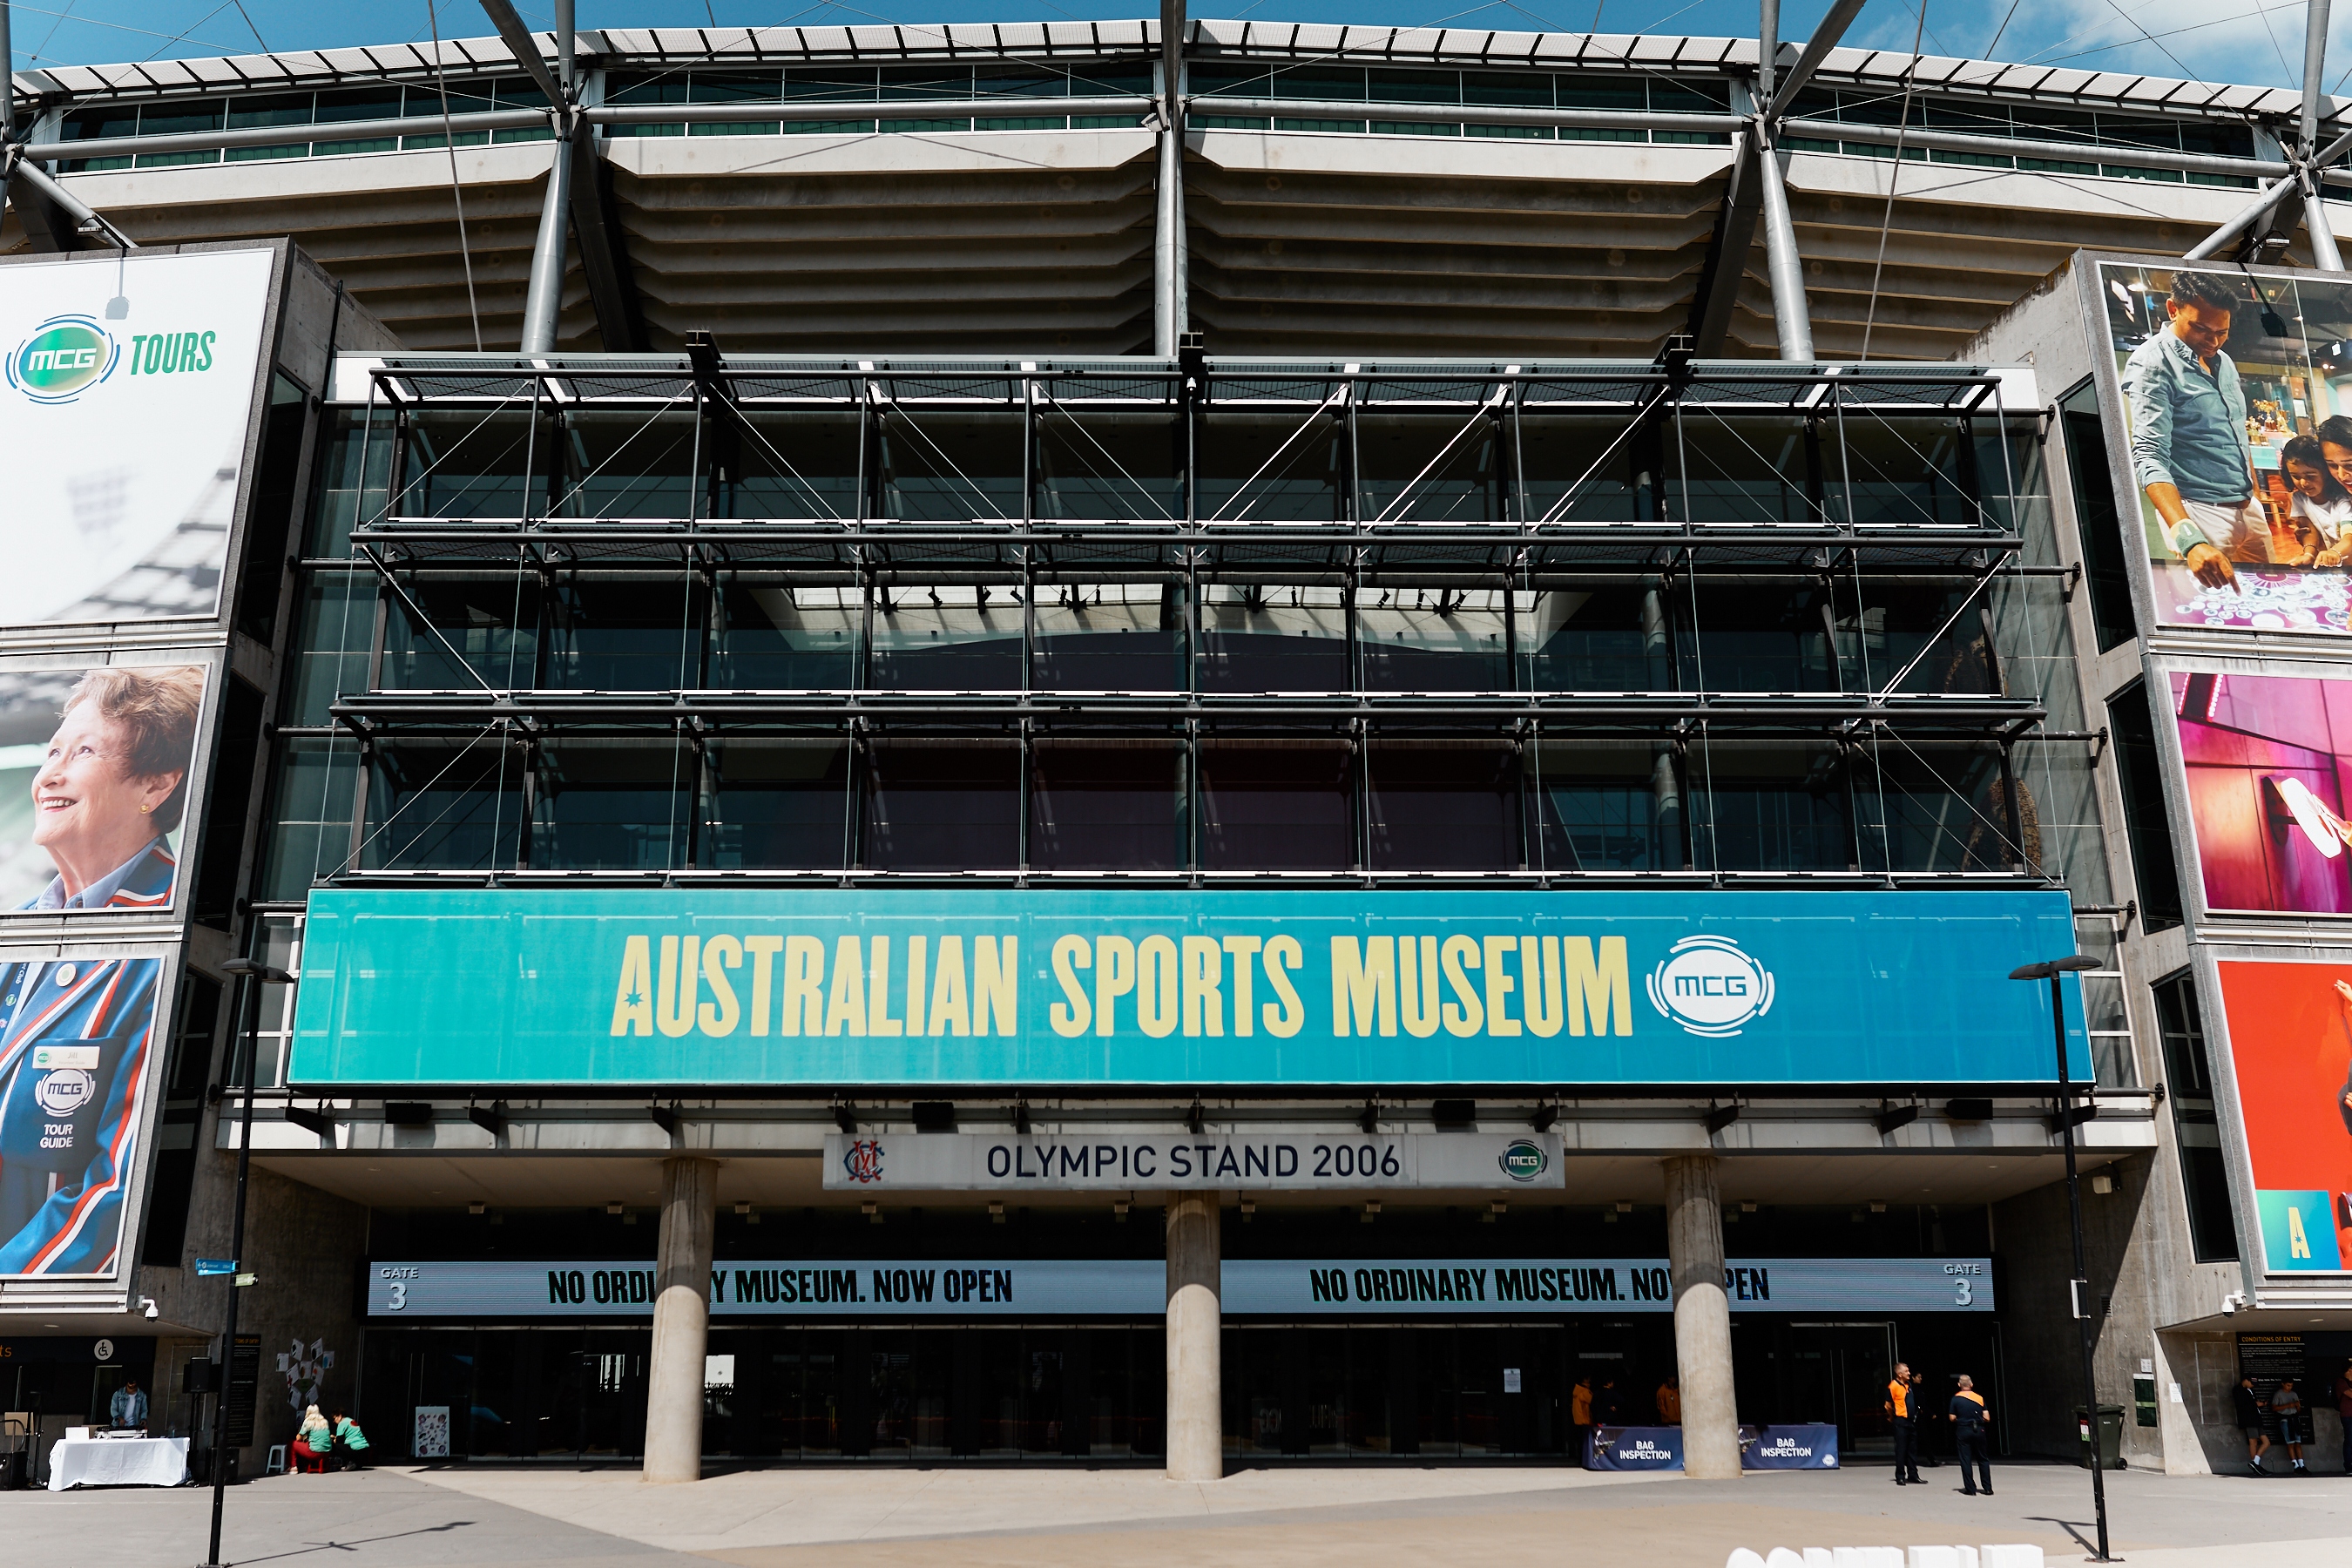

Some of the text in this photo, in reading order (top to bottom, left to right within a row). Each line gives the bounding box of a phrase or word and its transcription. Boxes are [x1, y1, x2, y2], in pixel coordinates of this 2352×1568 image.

[28, 330, 216, 375] MCG TOURS
[611, 934, 1633, 1037] AUSTRALIAN SPORTS MUSEUM
[1674, 976, 1747, 997] MCG
[47, 1083, 83, 1095] MCG
[44, 1124, 73, 1135] TOUR
[39, 1137, 73, 1148] GUIDE
[986, 1145, 1401, 1179] OLYMPIC STAND 2006
[1509, 1156, 1538, 1166] MCG
[381, 1267, 419, 1280] GATE
[1943, 1263, 1982, 1276] GATE
[548, 1269, 1013, 1304] NO ORDIY MUSEUM. NOW OPEN
[1309, 1268, 1348, 1302] NO
[1354, 1268, 1486, 1302] ORDINARY
[1495, 1268, 1626, 1301] MUSEUM.
[1630, 1267, 1673, 1301] NO
[388, 1282, 408, 1311] 3
[1955, 1278, 1974, 1307] 3
[1636, 1440, 1655, 1450] BAG
[1776, 1437, 1795, 1448] BAG
[1619, 1450, 1672, 1460] INSPECTION
[1761, 1447, 1812, 1457] INSPECTION
